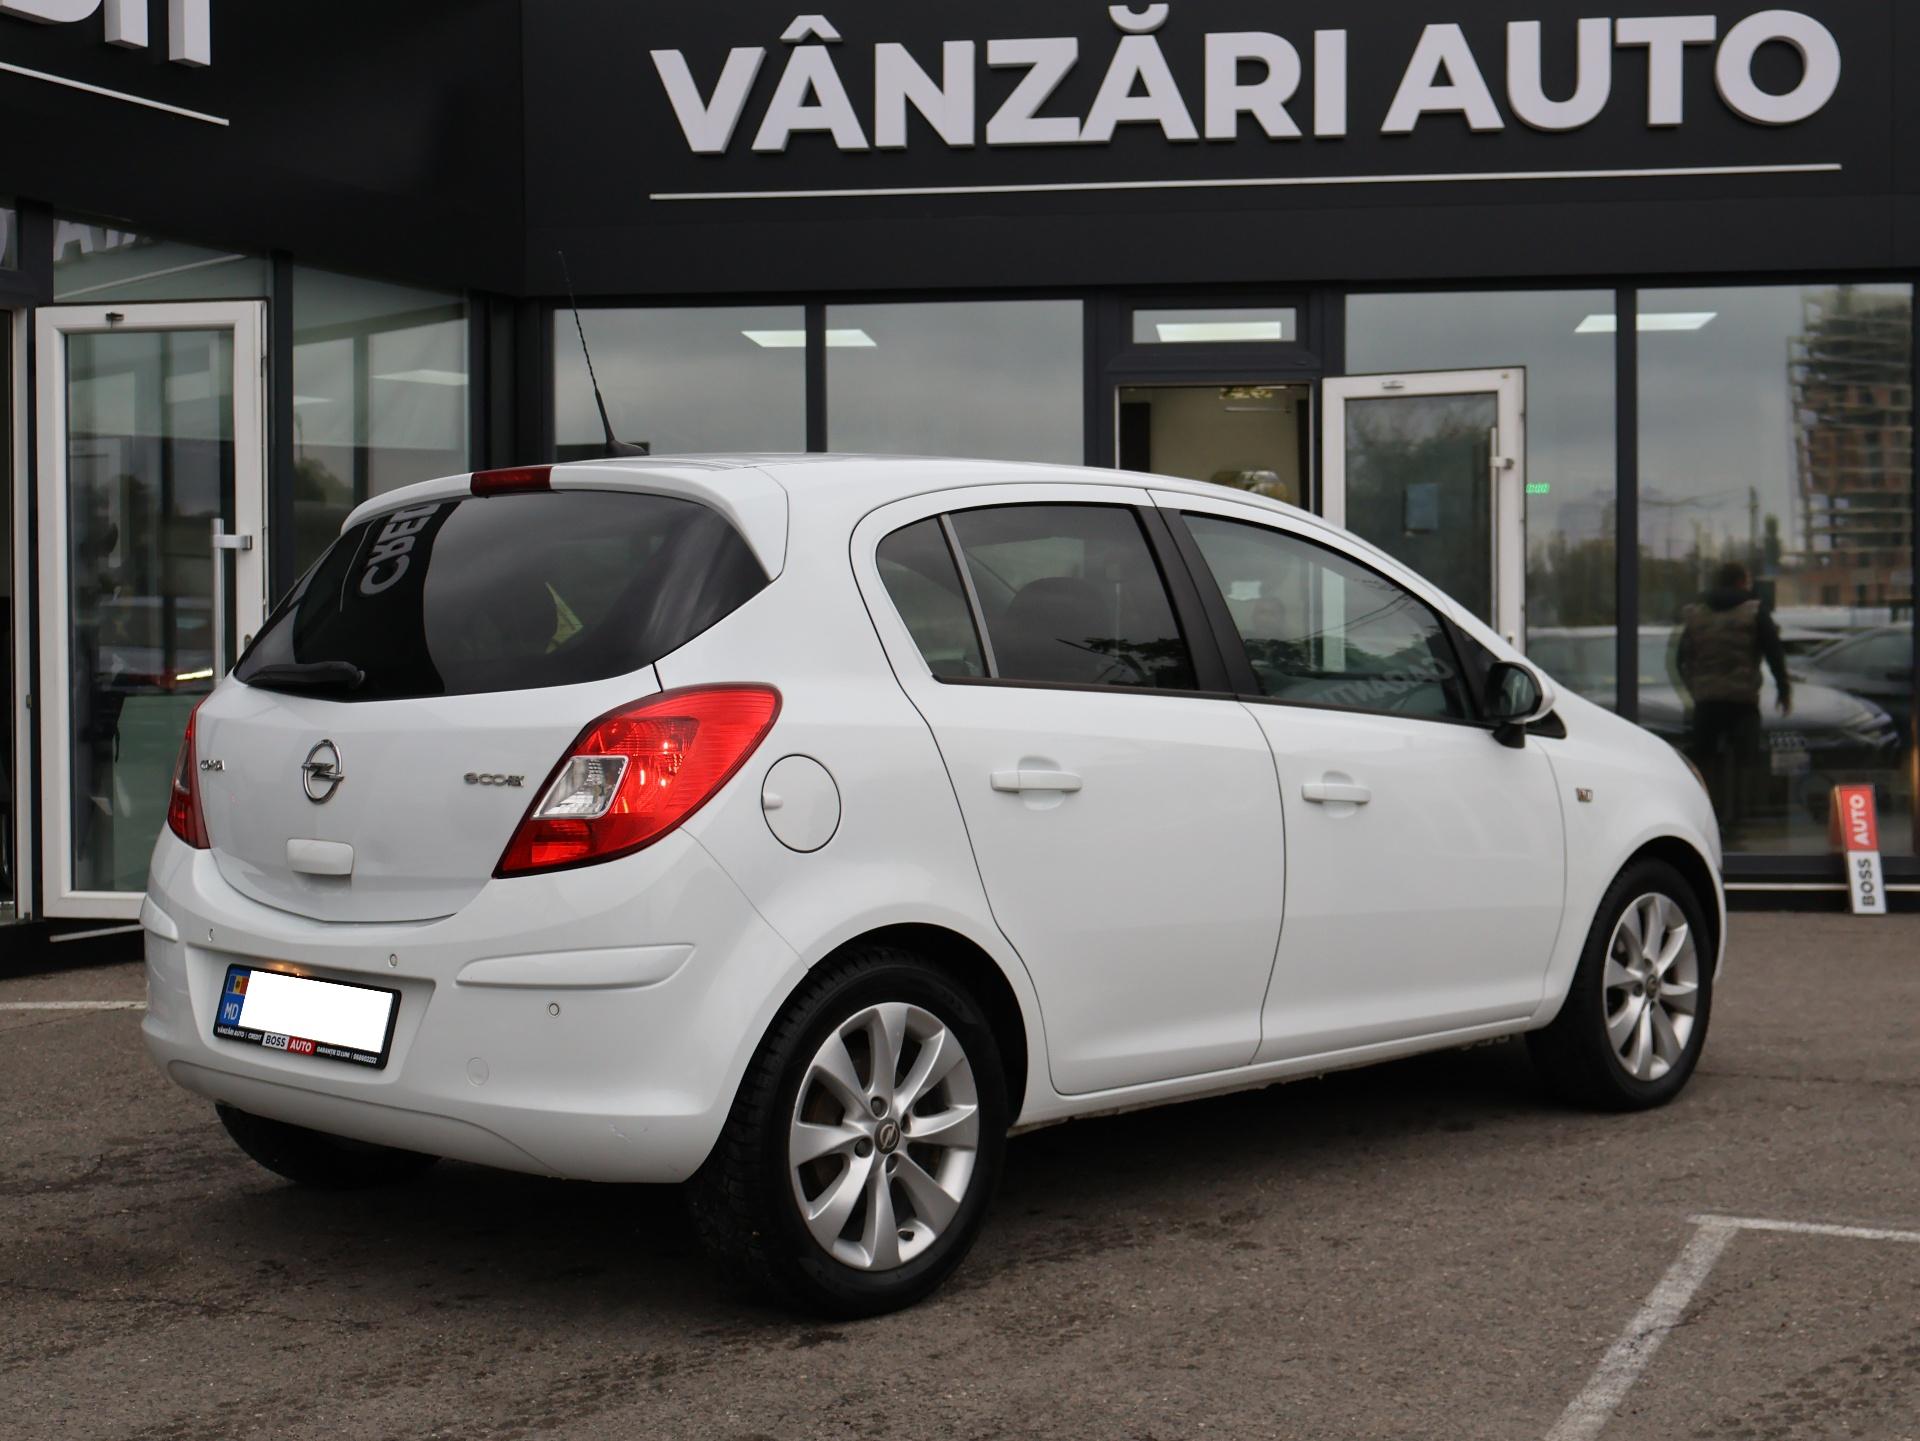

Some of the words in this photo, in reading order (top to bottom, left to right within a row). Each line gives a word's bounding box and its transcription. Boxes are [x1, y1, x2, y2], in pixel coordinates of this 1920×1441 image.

[650, 3, 1348, 154] VÂNZĂRI
[1380, 9, 1842, 133] AUTO
[1849, 793, 1872, 846] AUTO
[1857, 858, 1876, 907] BOSS
[223, 1002, 239, 1020] MD
[265, 1034, 286, 1047] BOSS
[290, 1039, 312, 1053] AUTO
